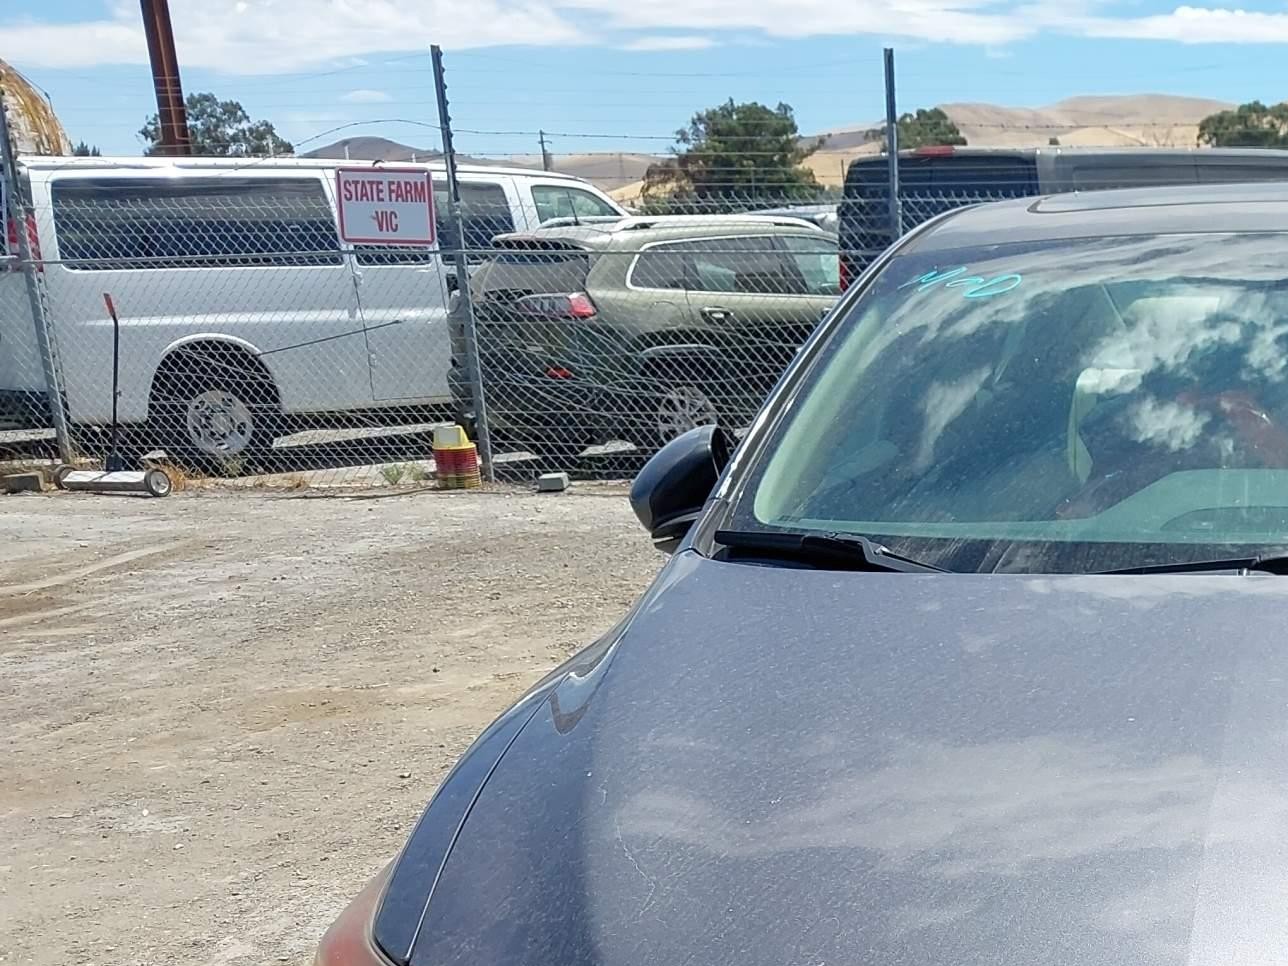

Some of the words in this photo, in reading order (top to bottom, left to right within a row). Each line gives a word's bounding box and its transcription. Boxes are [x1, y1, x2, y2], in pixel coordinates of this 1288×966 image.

[344, 180, 385, 202] STATE
[388, 181, 426, 203] FARM
[375, 210, 398, 233] VIC
